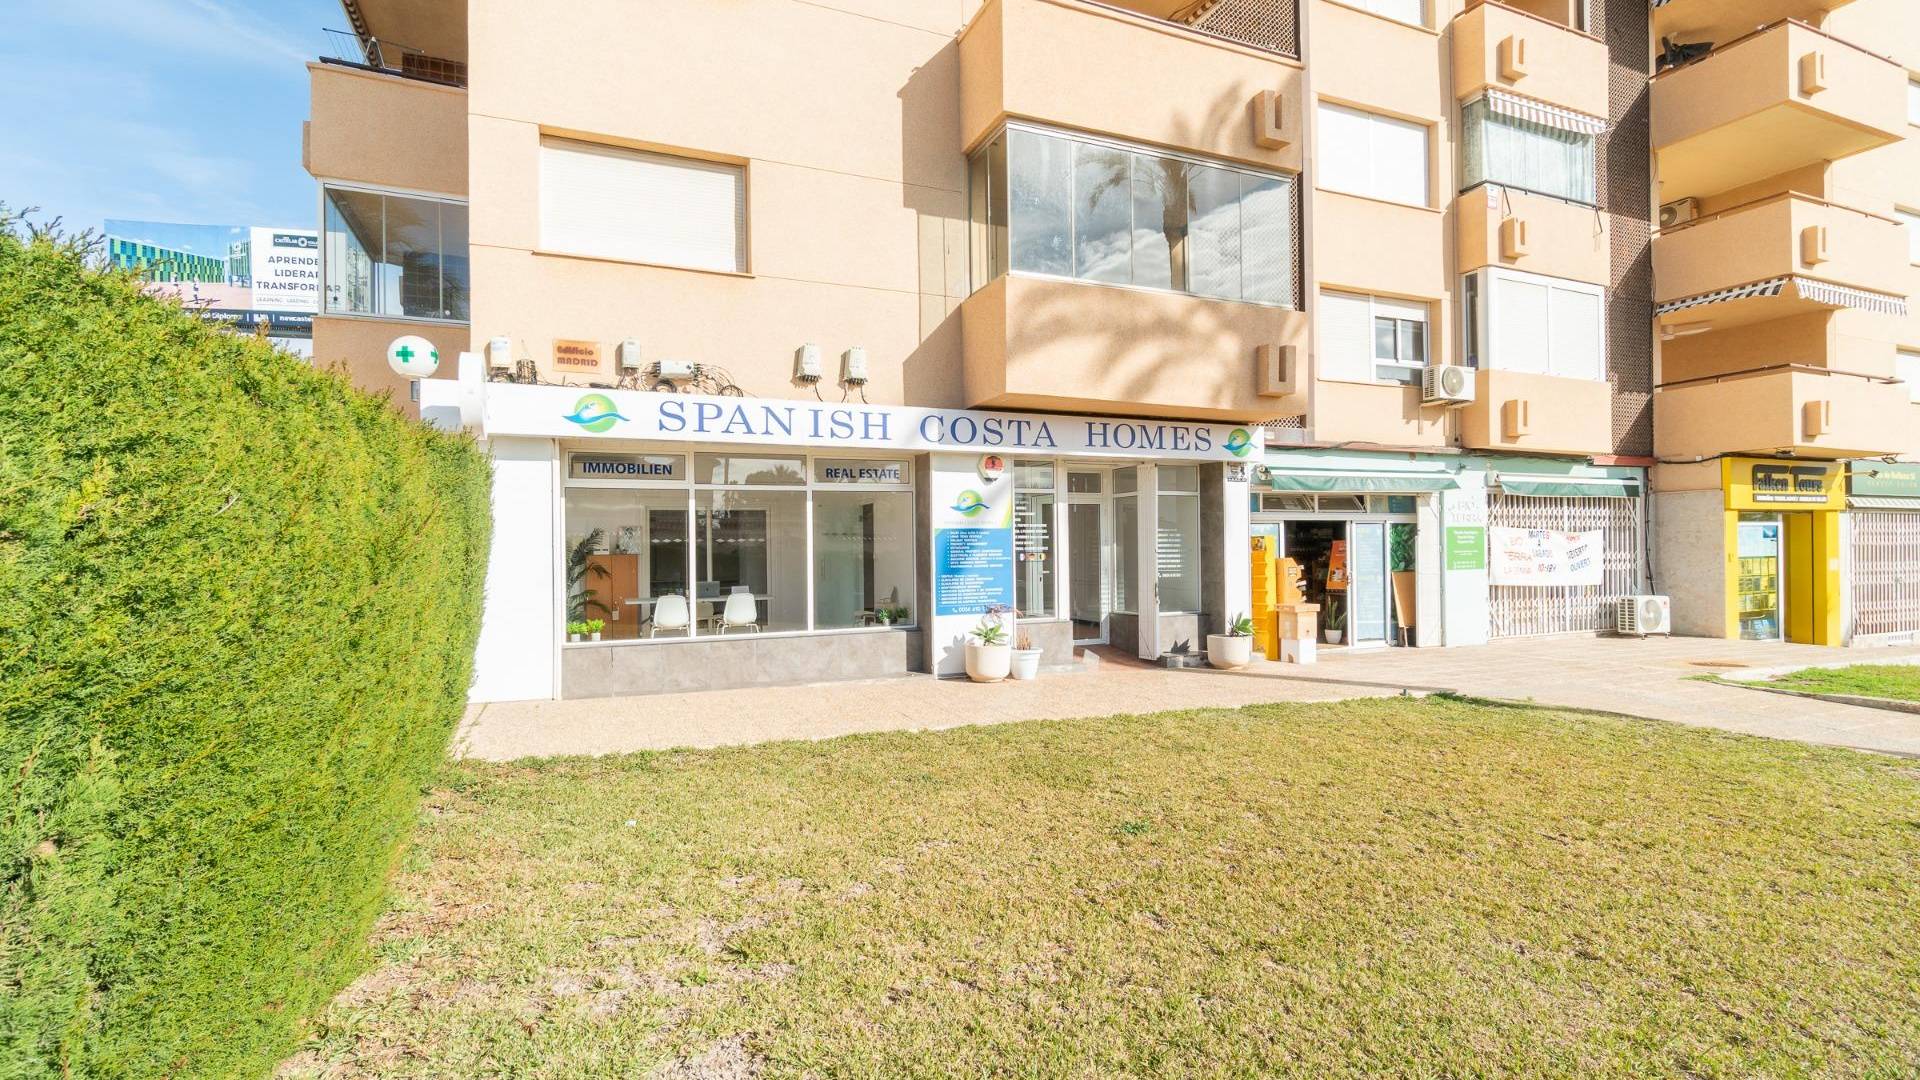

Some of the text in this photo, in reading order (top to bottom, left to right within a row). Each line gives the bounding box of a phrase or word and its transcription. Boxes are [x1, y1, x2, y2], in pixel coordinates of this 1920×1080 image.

[268, 255, 319, 266] APRENDE
[556, 357, 599, 367] MADRID
[658, 400, 1213, 452] SPANISH COSTA HOMES
[582, 460, 673, 476] IMMOBILIEN
[825, 467, 901, 480] REAL ESTATE
